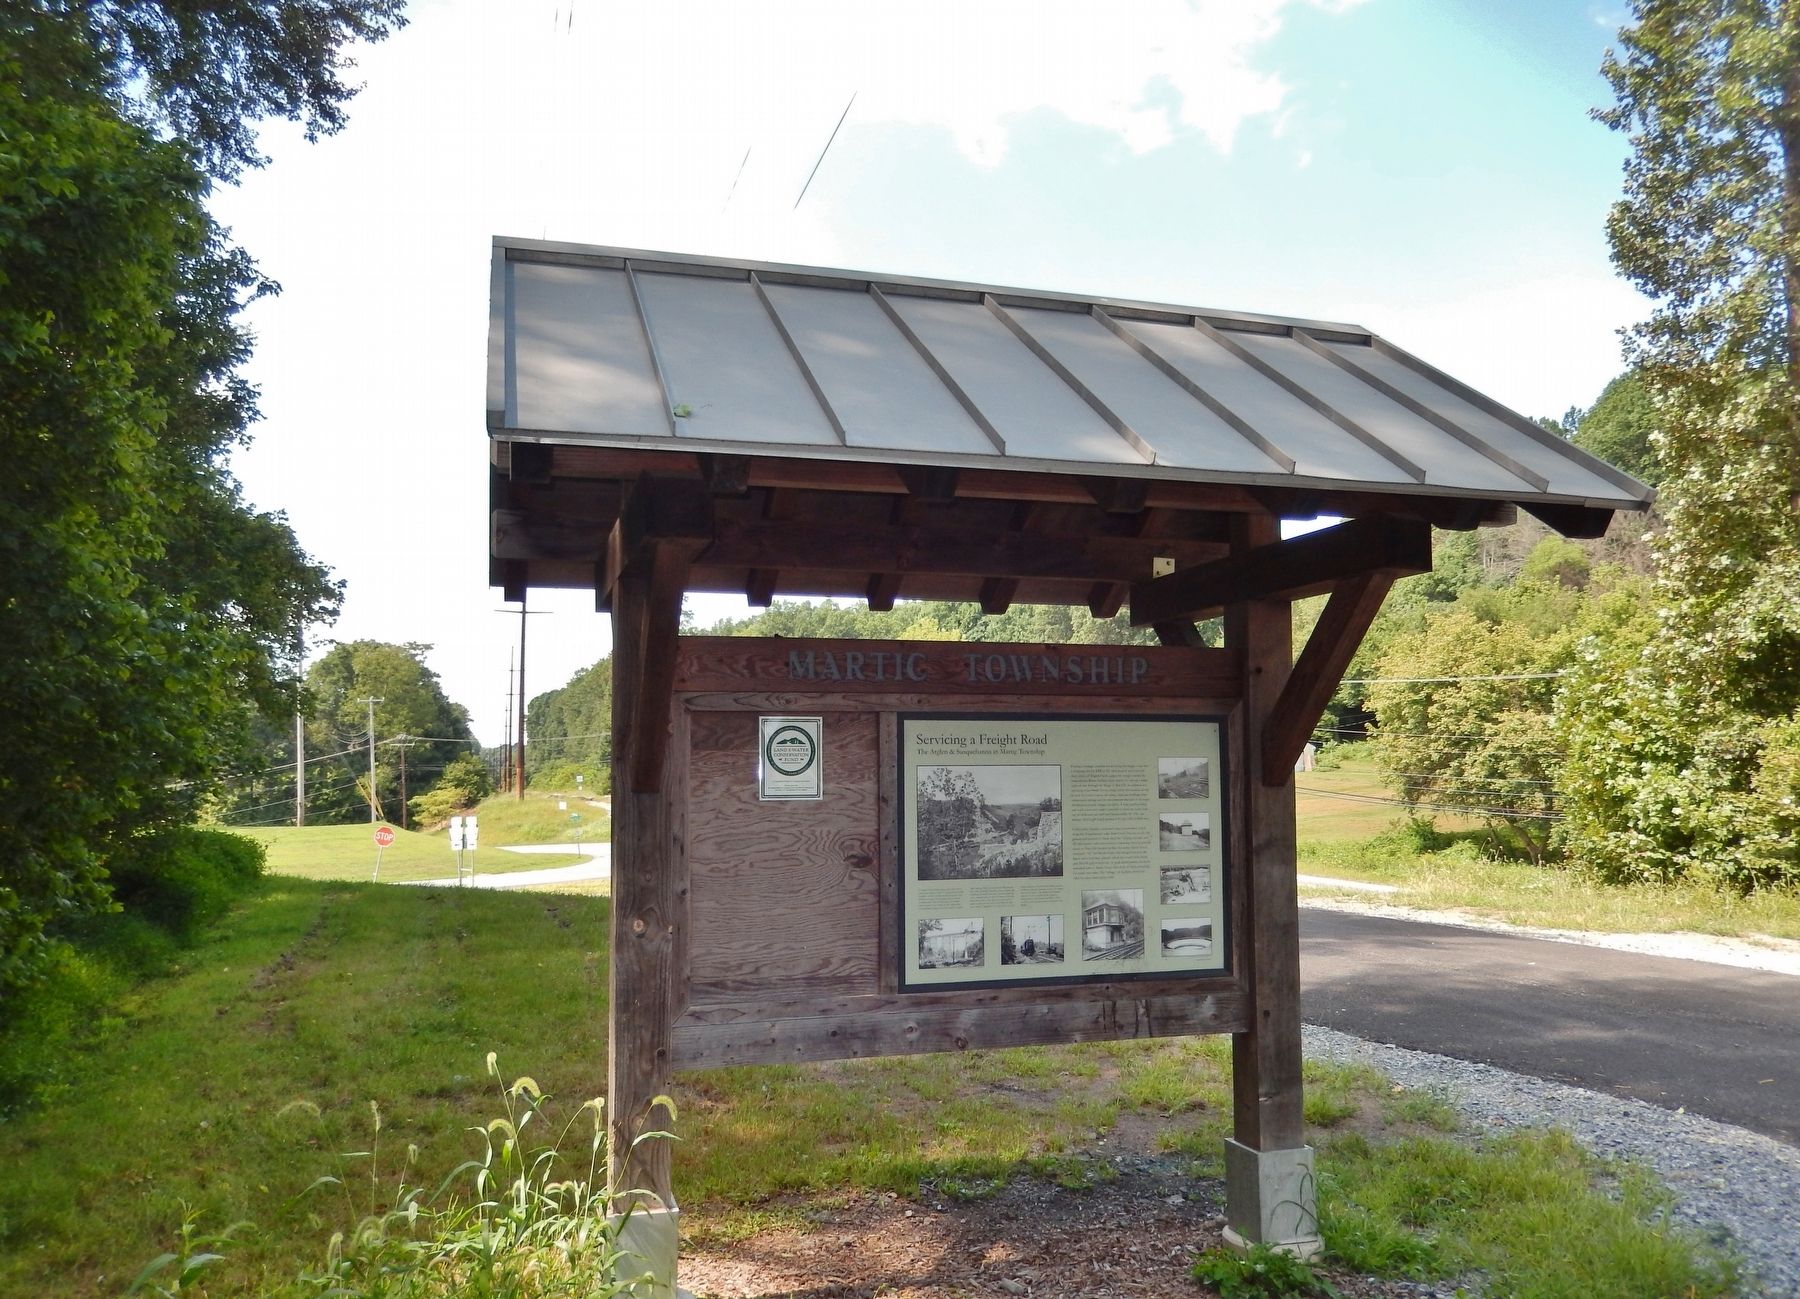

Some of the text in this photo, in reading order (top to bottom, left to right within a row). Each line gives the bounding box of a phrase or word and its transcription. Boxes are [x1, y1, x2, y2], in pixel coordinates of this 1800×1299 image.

[788, 650, 1148, 684] MARTIC TOWNSHIP
[916, 733, 967, 748] Servicing
[979, 733, 1017, 748] Freight
[1021, 733, 1048, 745] Road
[1018, 748, 1046, 758] Township
[376, 832, 394, 840] STOP
